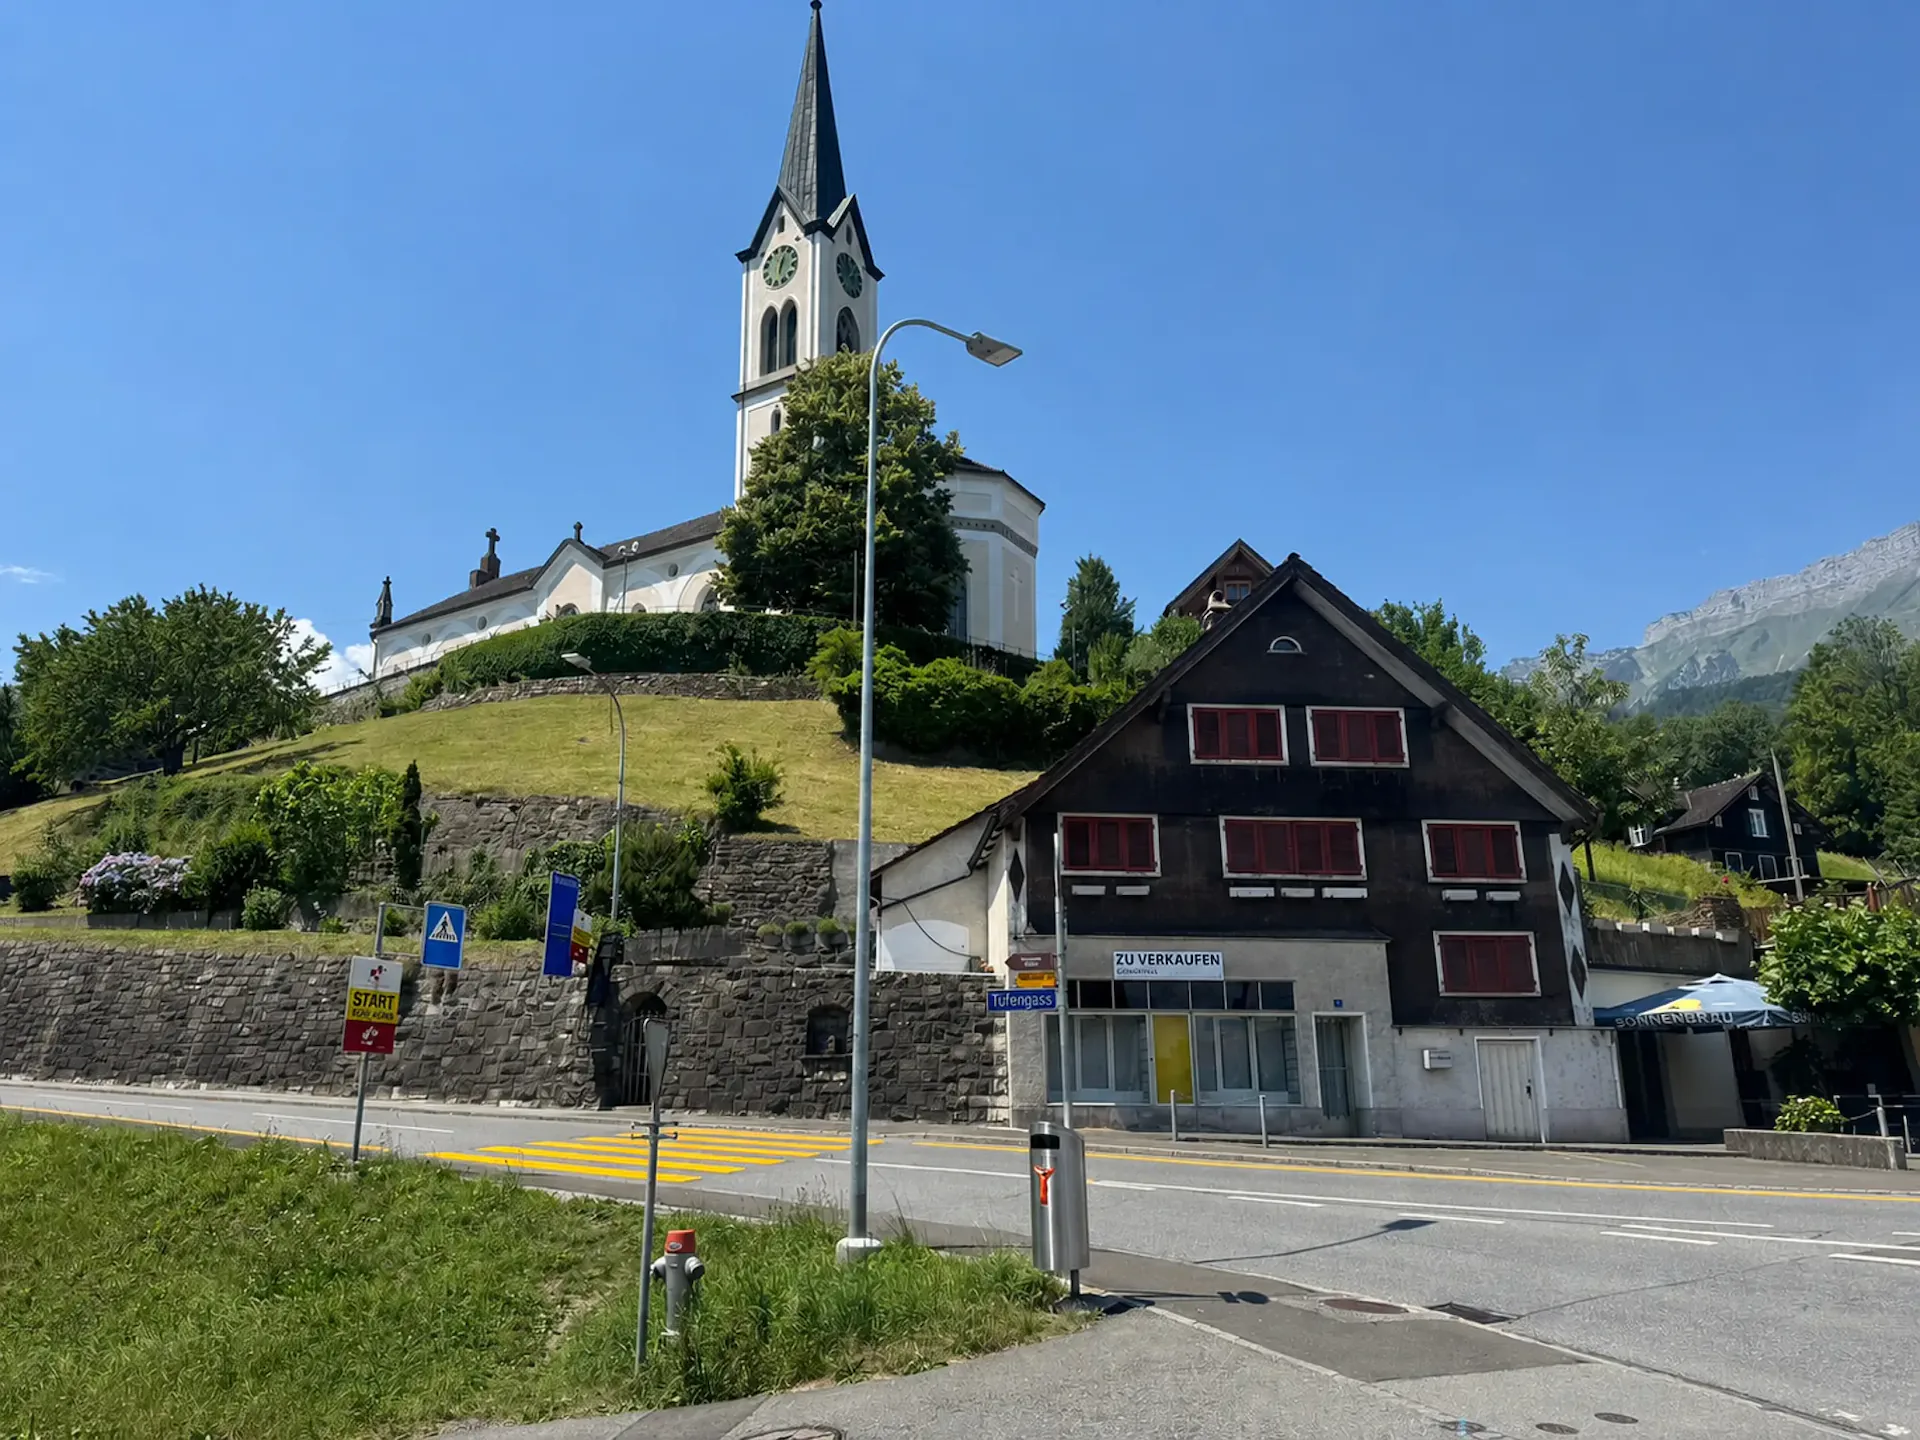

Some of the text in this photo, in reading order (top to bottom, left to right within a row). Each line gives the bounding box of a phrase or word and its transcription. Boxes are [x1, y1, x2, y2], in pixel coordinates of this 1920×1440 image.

[1115, 953, 1220, 965] ZU VERKAUFEN
[352, 991, 395, 1010] START
